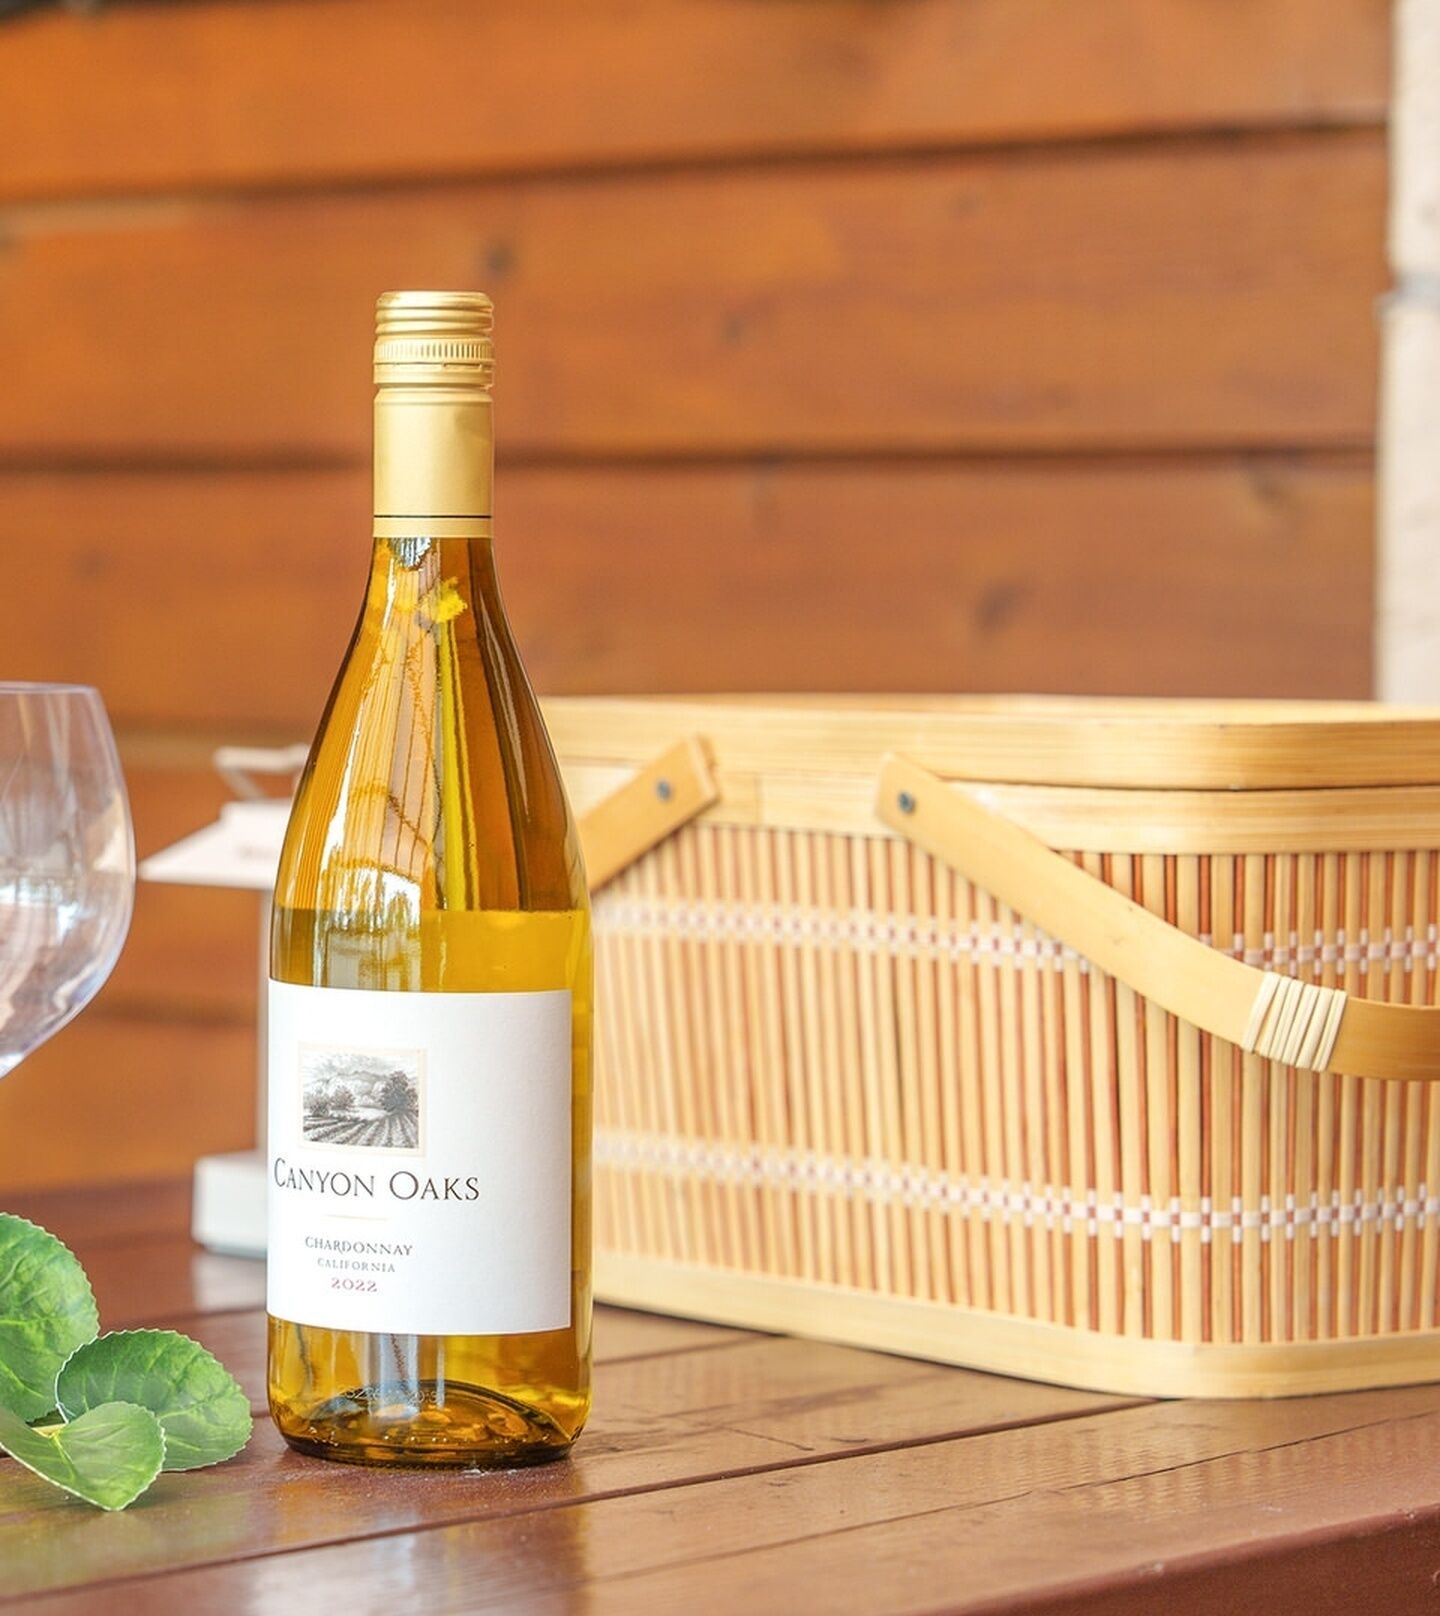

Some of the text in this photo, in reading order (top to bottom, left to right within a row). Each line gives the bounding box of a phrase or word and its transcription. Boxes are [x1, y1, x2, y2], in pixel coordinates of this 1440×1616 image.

[273, 1157, 480, 1201] CANYON OAKS
[304, 1236, 413, 1256] CHARDONNAY
[317, 1258, 396, 1273] CALIFORNIA
[331, 1277, 378, 1292] 2022
